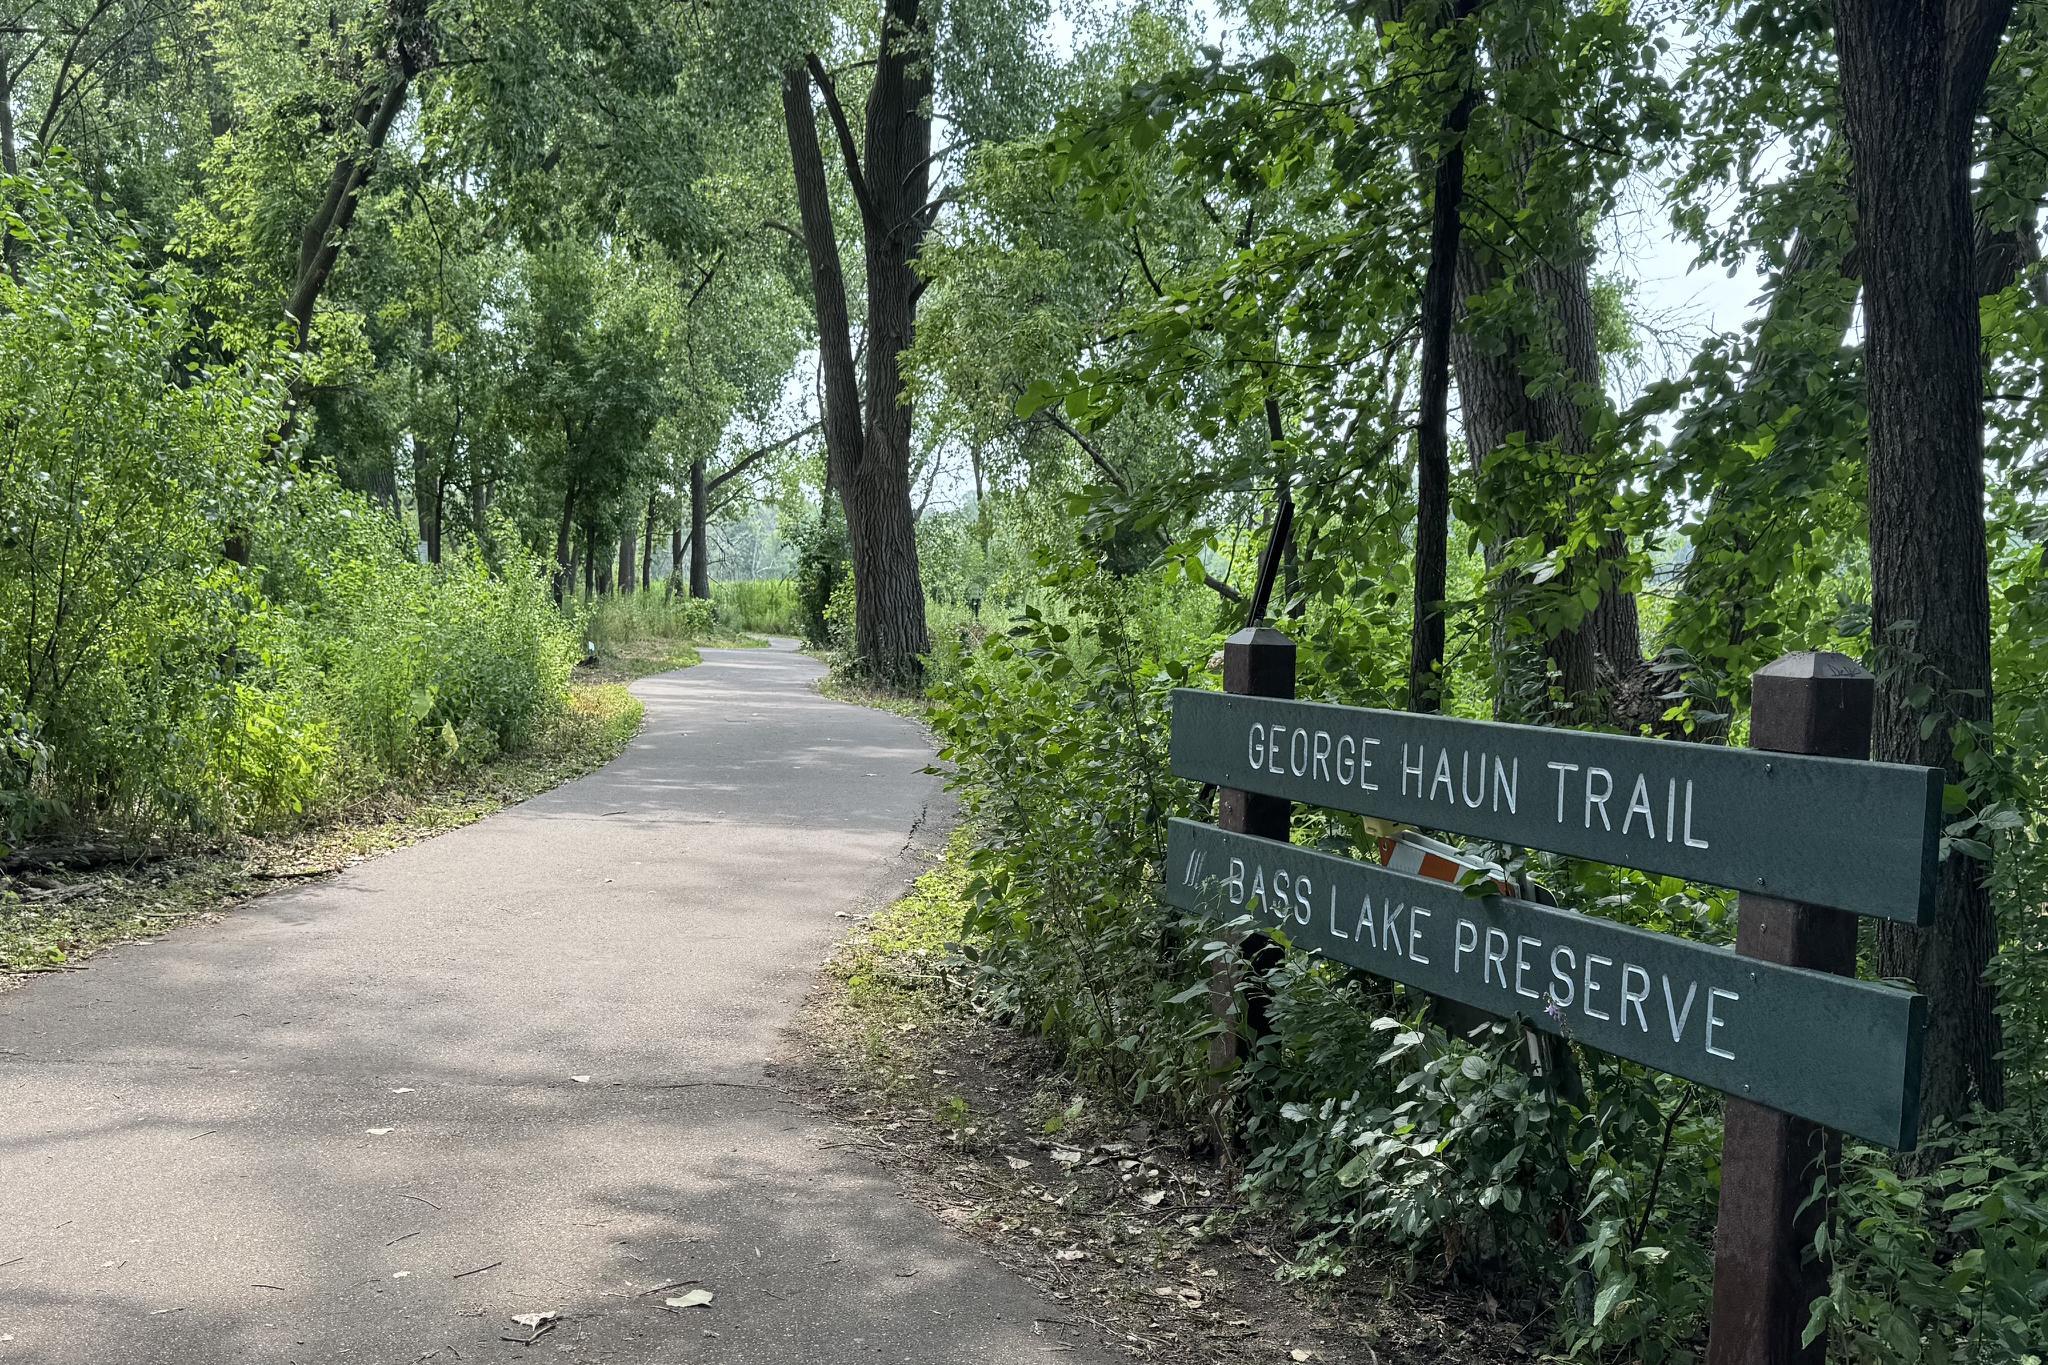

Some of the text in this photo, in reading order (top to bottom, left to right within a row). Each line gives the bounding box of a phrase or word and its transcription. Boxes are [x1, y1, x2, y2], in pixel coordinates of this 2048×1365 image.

[1248, 721, 1709, 850] GEORGE HAUN TRAIL
[1229, 856, 1740, 1061] BASS LAKE PRESERVE
